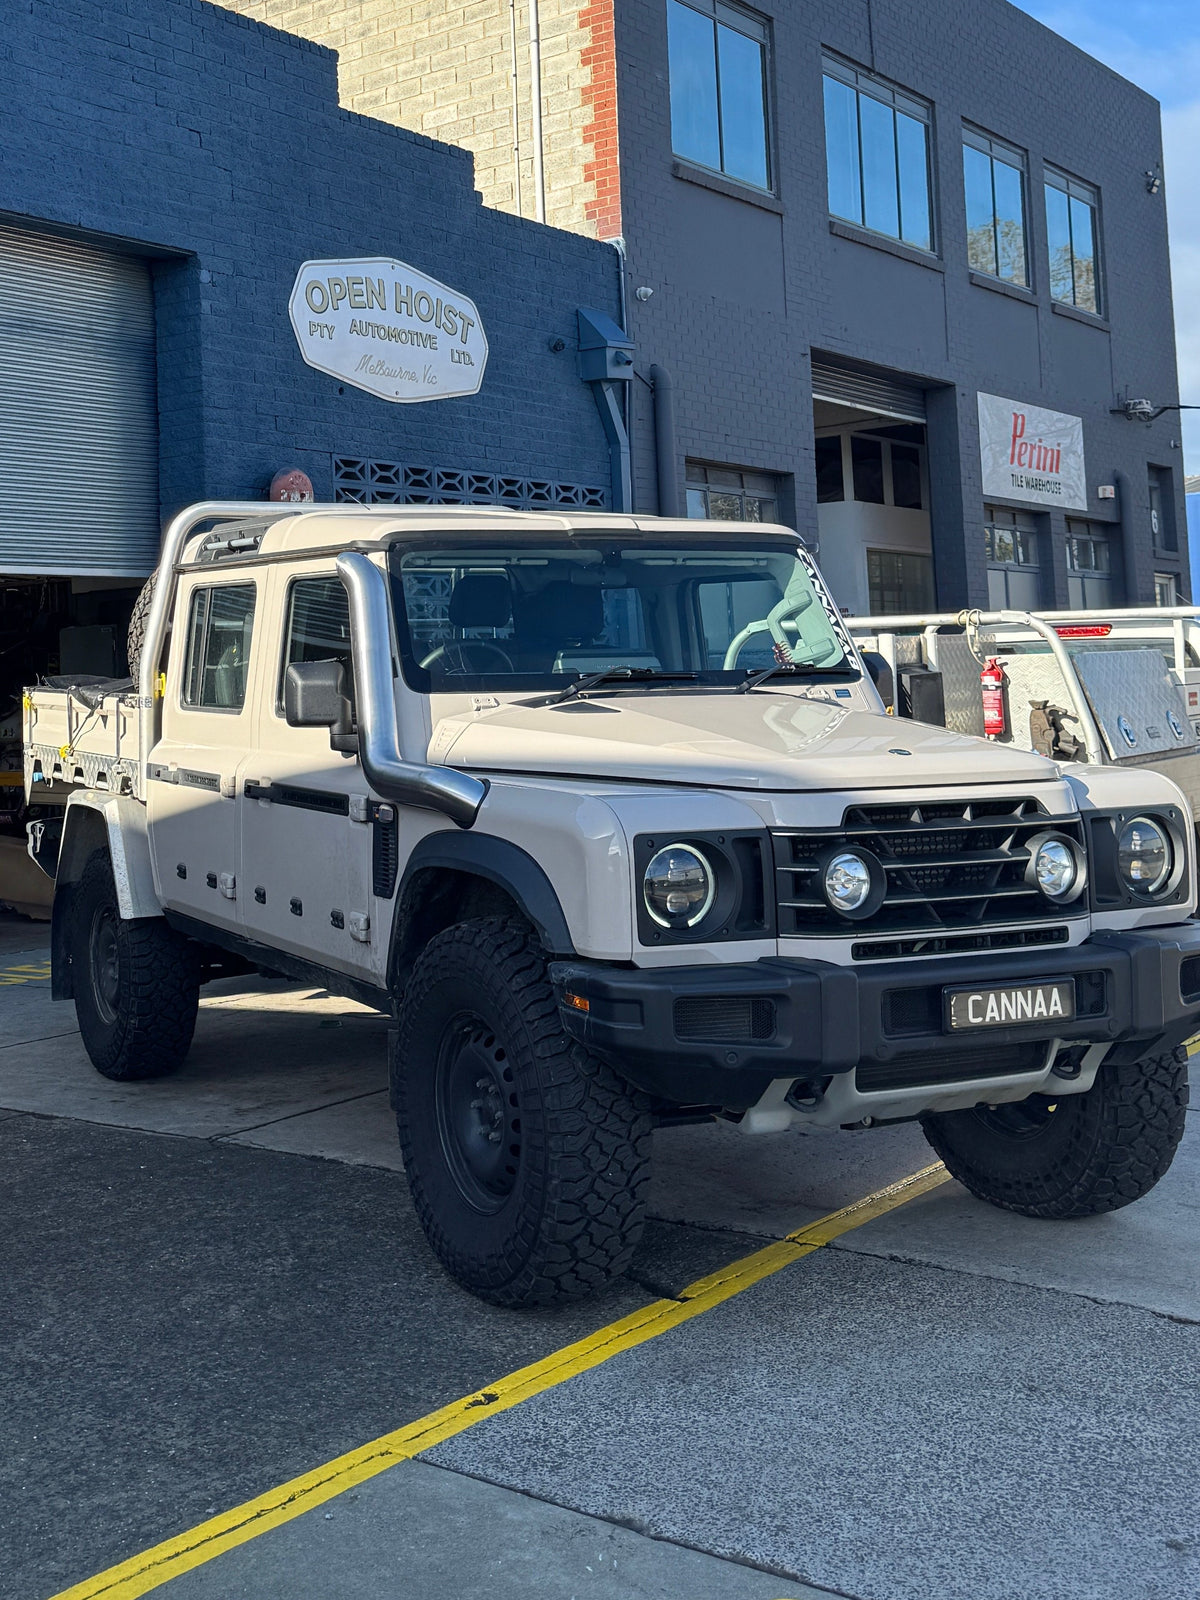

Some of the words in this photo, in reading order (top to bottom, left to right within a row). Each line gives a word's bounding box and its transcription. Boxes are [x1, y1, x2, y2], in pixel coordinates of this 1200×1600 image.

[305, 276, 386, 314] OPEN
[395, 281, 475, 344] HOIST
[308, 320, 335, 340] PTY
[349, 319, 438, 350] AUTOMOTIVE
[450, 348, 475, 366] LTD.
[422, 364, 438, 385] Vic
[1009, 412, 1061, 474] Perini
[1010, 473, 1024, 489] TILE
[1024, 476, 1061, 495] WAREHOUSE
[1151, 509, 1159, 534] 6
[967, 987, 1063, 1024] CANNAA
